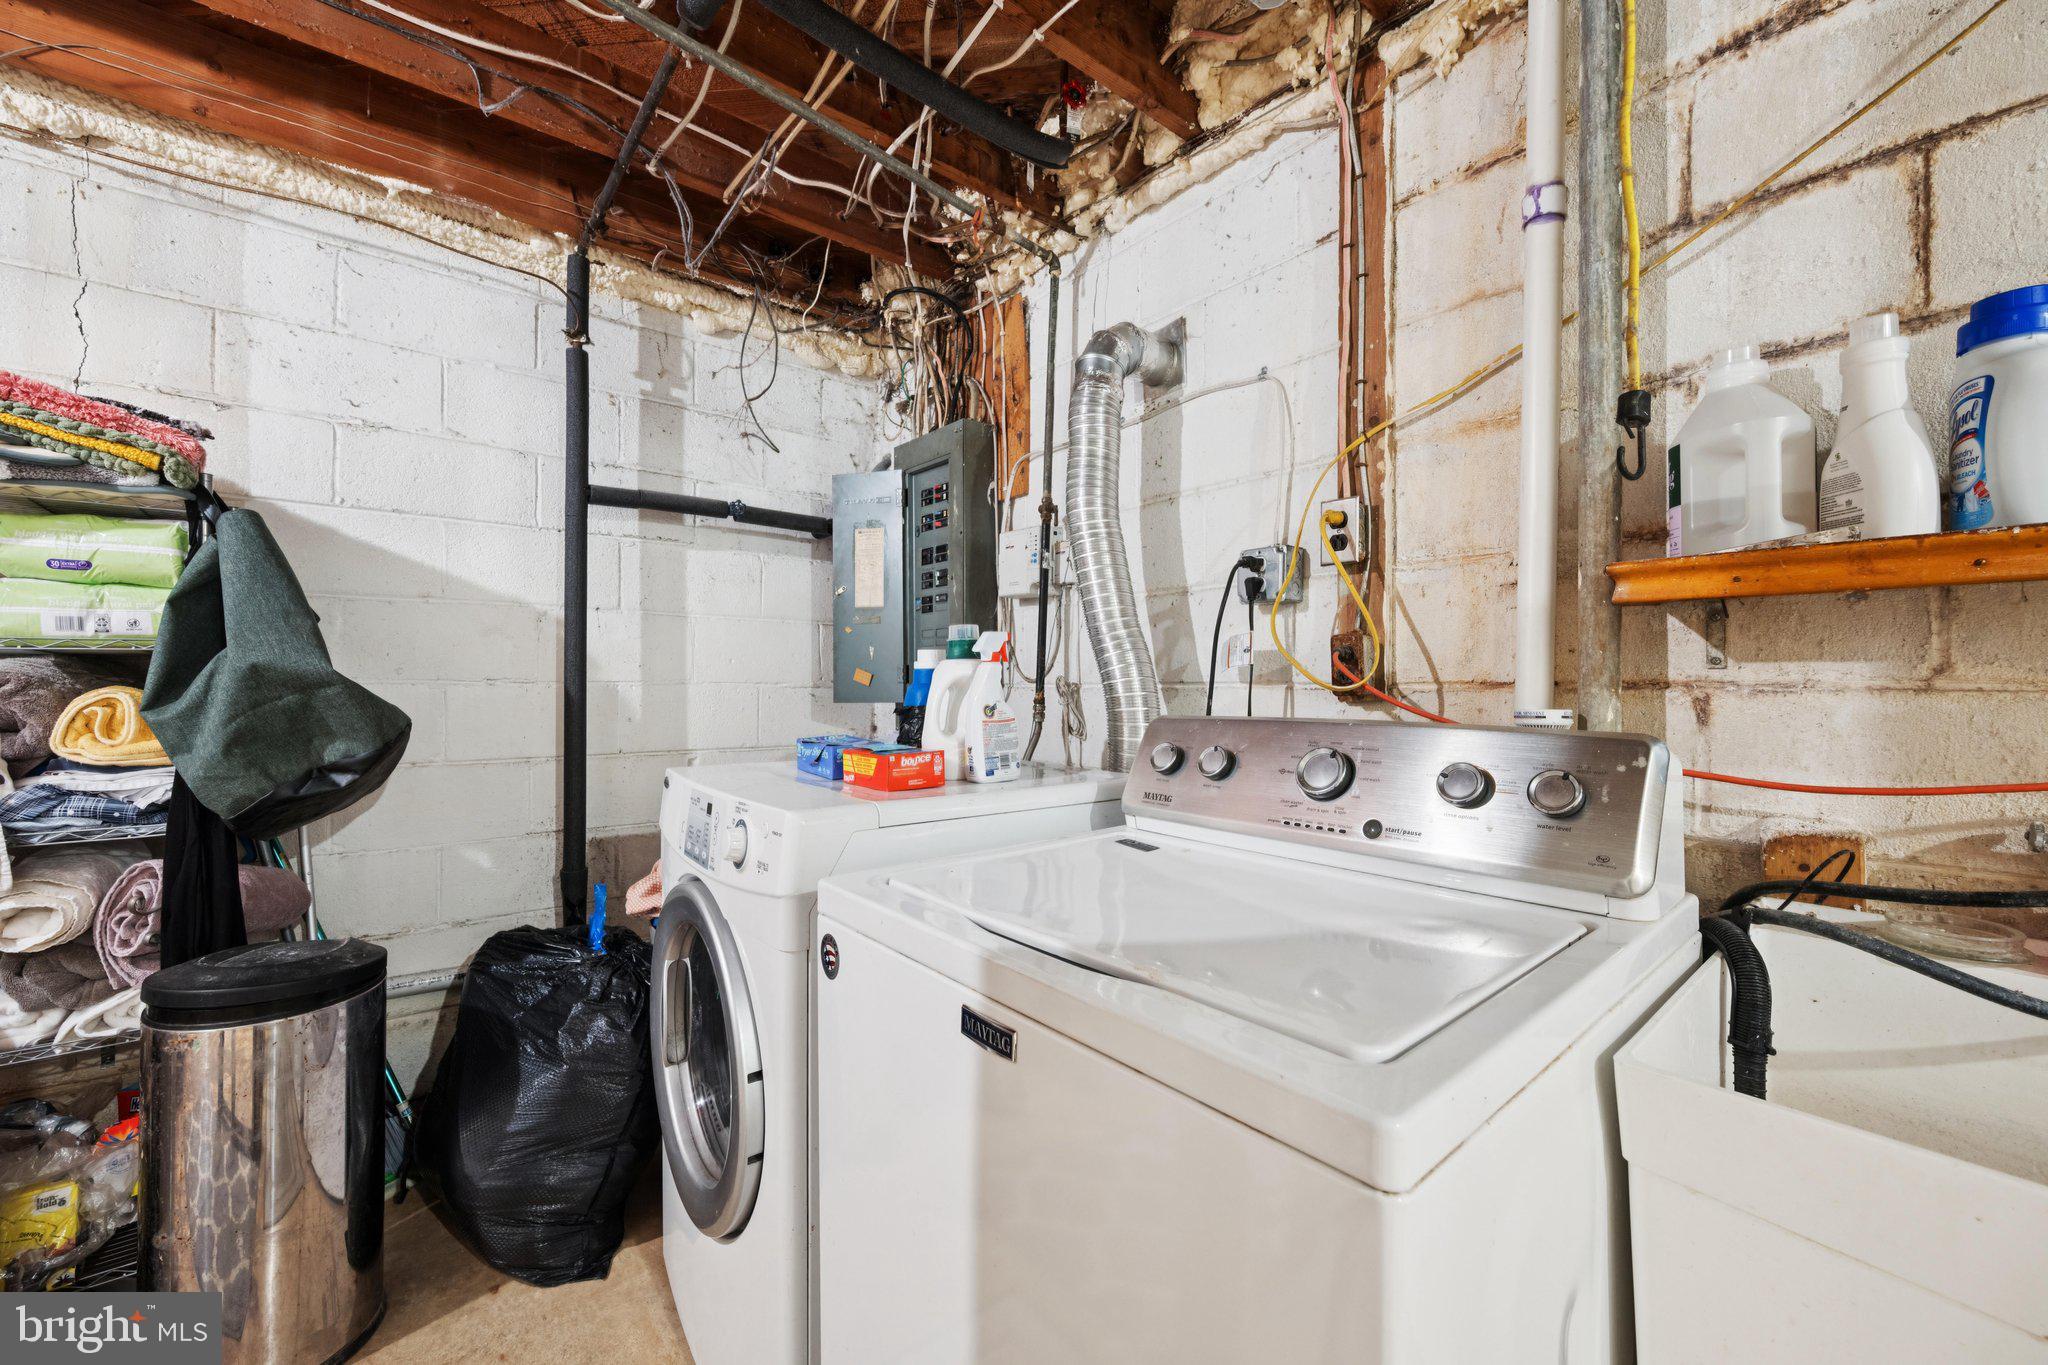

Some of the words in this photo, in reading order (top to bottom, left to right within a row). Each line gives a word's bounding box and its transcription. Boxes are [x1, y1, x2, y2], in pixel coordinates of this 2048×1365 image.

[901, 754, 931, 766] bounce
[1143, 792, 1173, 803] MAYTAG
[1385, 826, 1422, 837] start/pause
[965, 1014, 1011, 1053] MAYTAG
